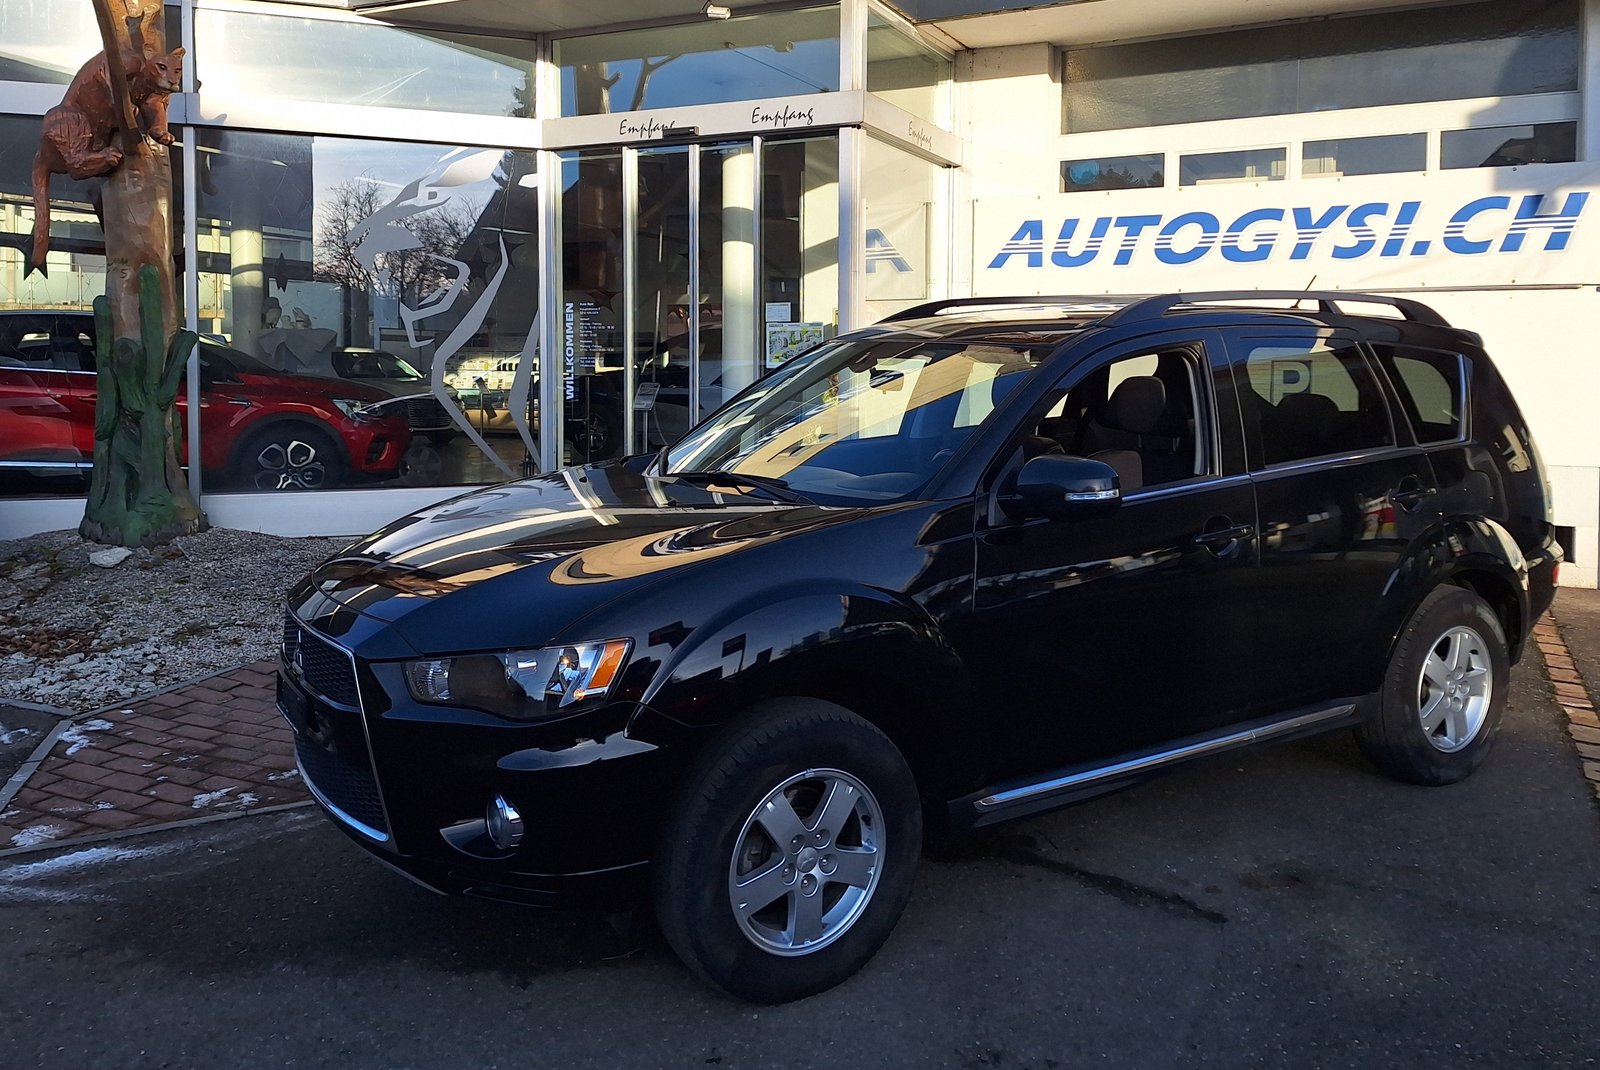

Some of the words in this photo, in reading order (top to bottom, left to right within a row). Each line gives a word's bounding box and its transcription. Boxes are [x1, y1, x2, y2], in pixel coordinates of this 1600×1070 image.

[751, 104, 814, 128] Empfang
[987, 191, 1591, 269] AUTOGYSI.CH
[565, 302, 575, 400] WILLKOMMEN
